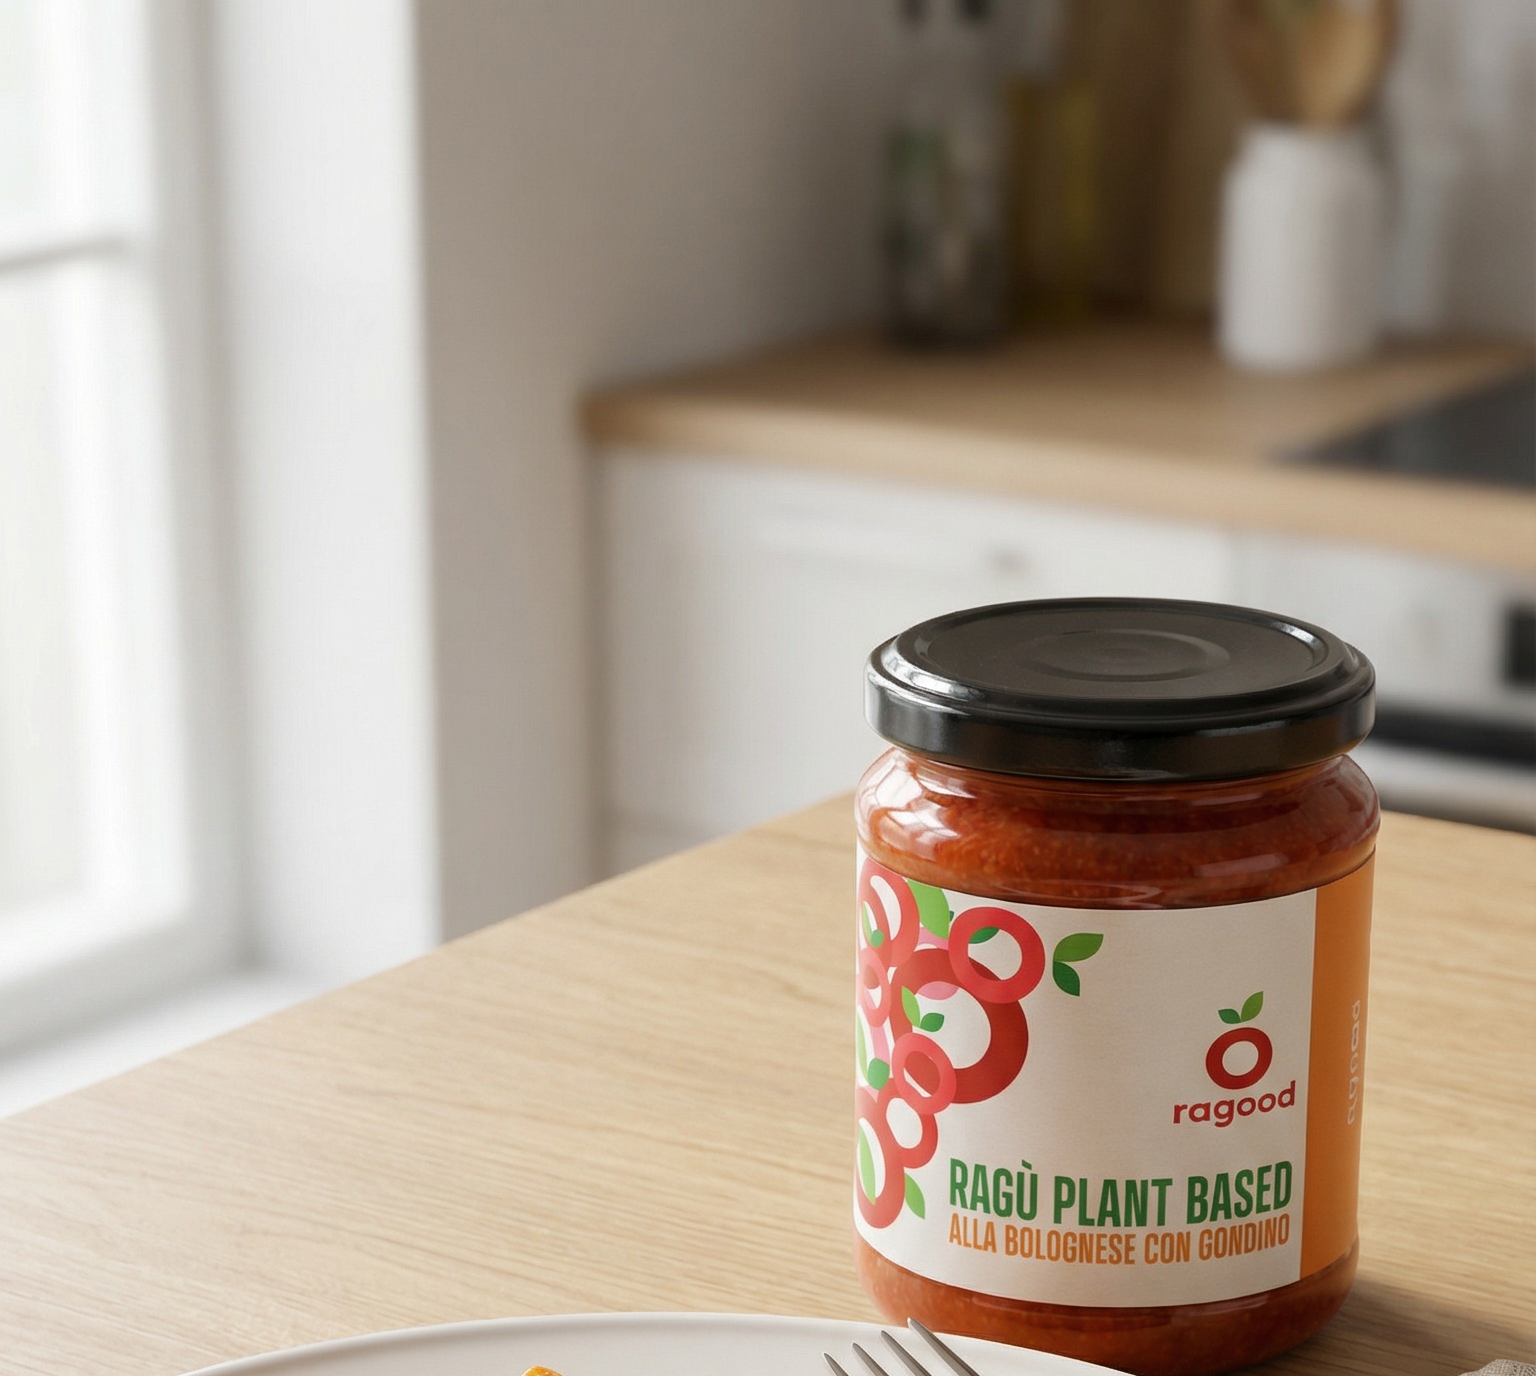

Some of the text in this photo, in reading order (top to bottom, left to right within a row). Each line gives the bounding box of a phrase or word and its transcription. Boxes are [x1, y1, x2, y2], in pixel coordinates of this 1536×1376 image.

[1173, 1080, 1296, 1128] ragood
[949, 1158, 1293, 1228] RAGÙ PLANT BASED
[948, 1212, 1290, 1265] ALLA BOLOGNESE CON GONDINO
